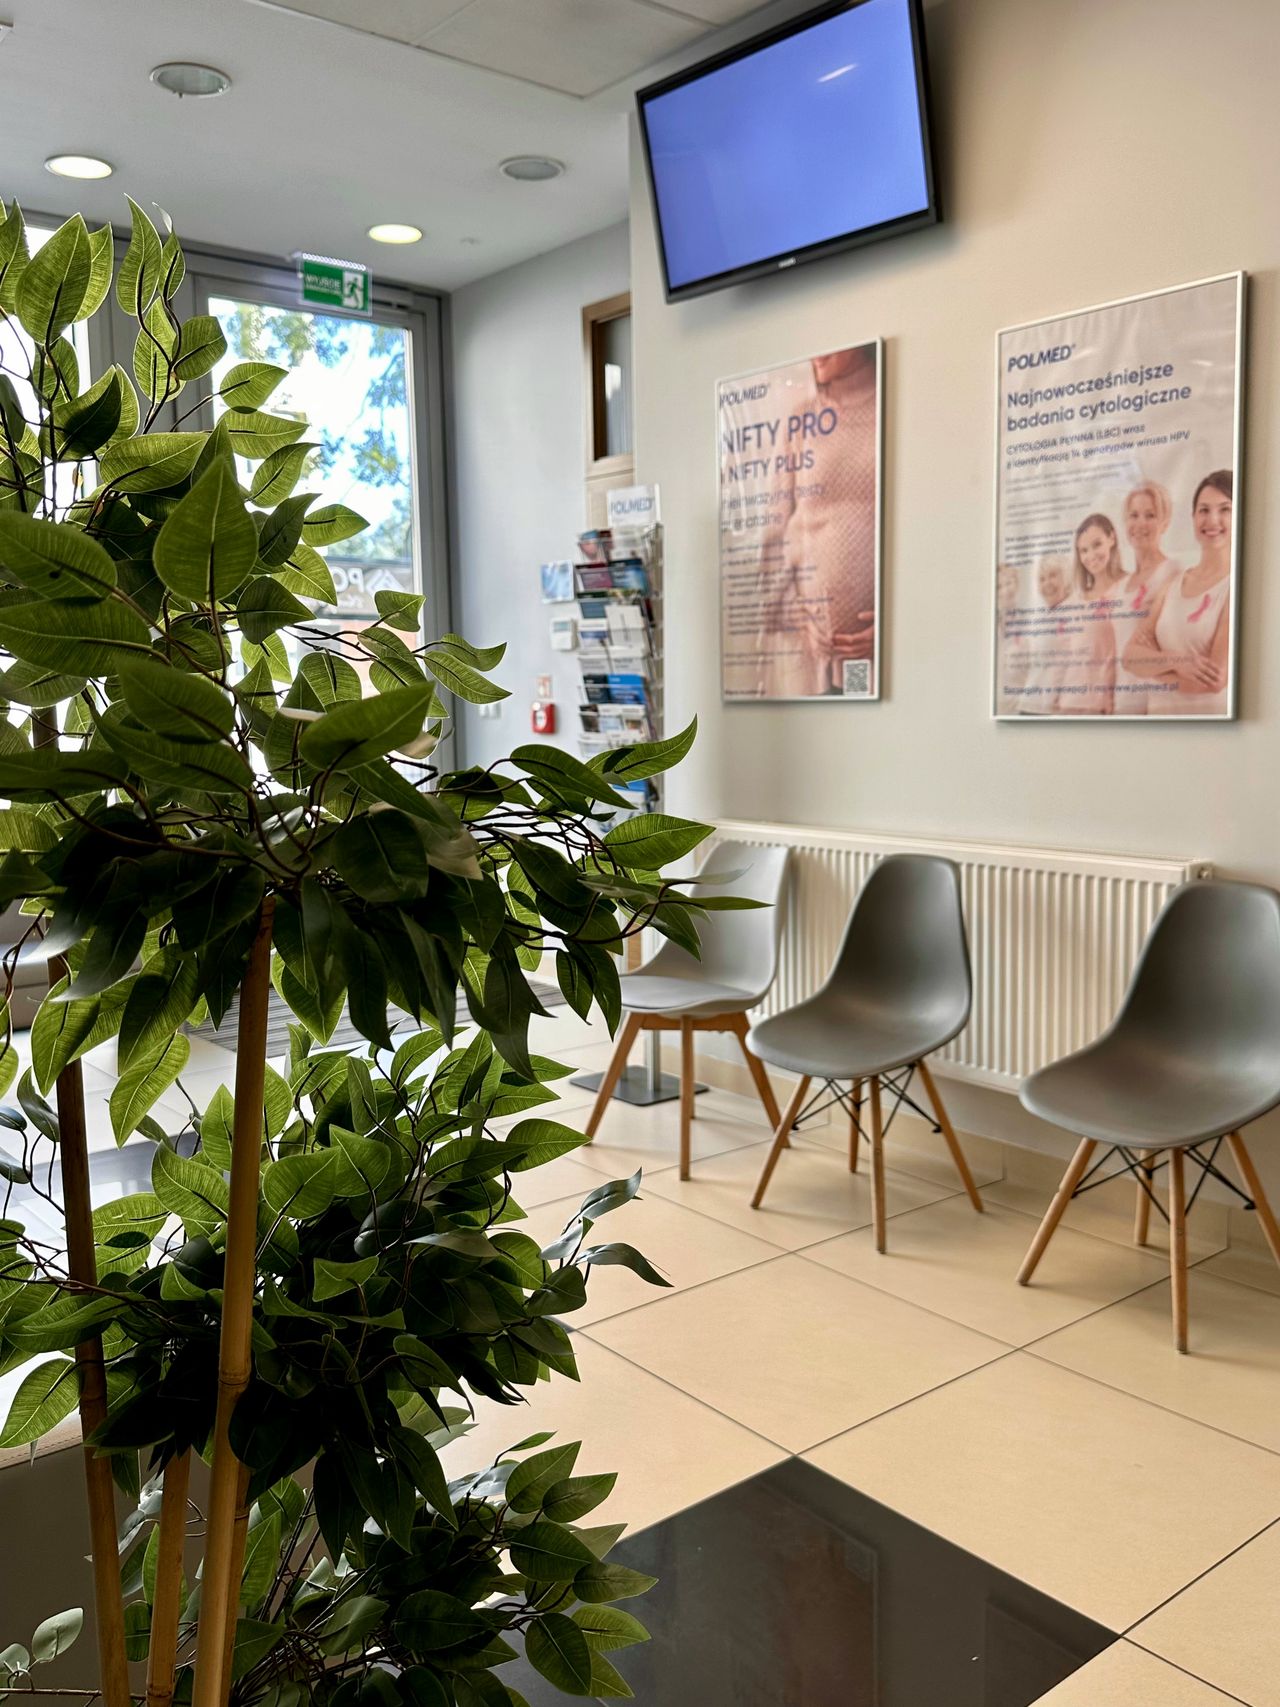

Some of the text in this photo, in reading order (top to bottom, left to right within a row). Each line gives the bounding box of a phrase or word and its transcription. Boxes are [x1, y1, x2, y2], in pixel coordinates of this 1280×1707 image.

[1007, 344, 1073, 372] POLMED
[1007, 364, 1174, 408] Najnowocześniejsze
[723, 407, 837, 454] NIFTY PRO
[1007, 386, 1192, 431] badania cytologiczne
[728, 457, 771, 482] NIFTY
[775, 449, 815, 474] PLUS
